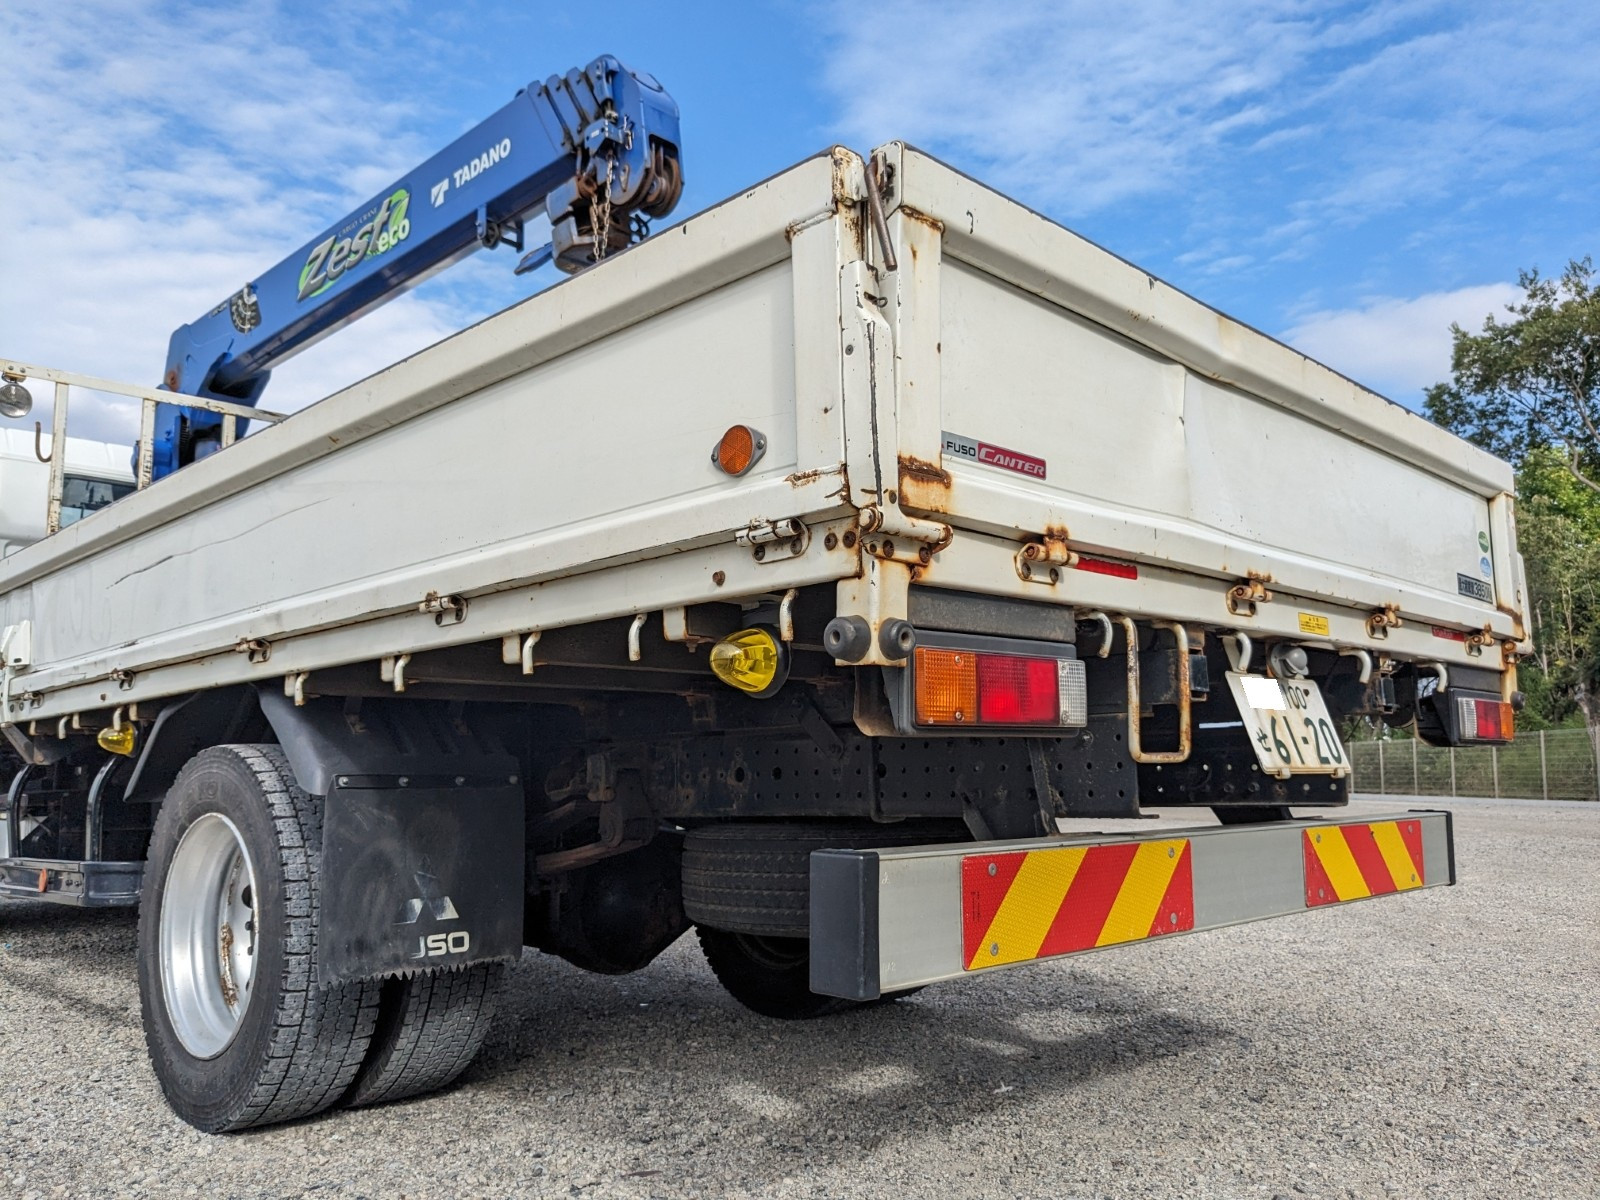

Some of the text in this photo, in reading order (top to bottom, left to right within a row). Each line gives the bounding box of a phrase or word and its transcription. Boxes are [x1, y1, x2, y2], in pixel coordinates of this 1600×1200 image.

[453, 138, 511, 188] TADANO
[297, 196, 394, 301] Zest
[378, 218, 410, 253] eco
[946, 441, 1045, 476] FUSO CANTER
[1270, 715, 1342, 765] 61-20
